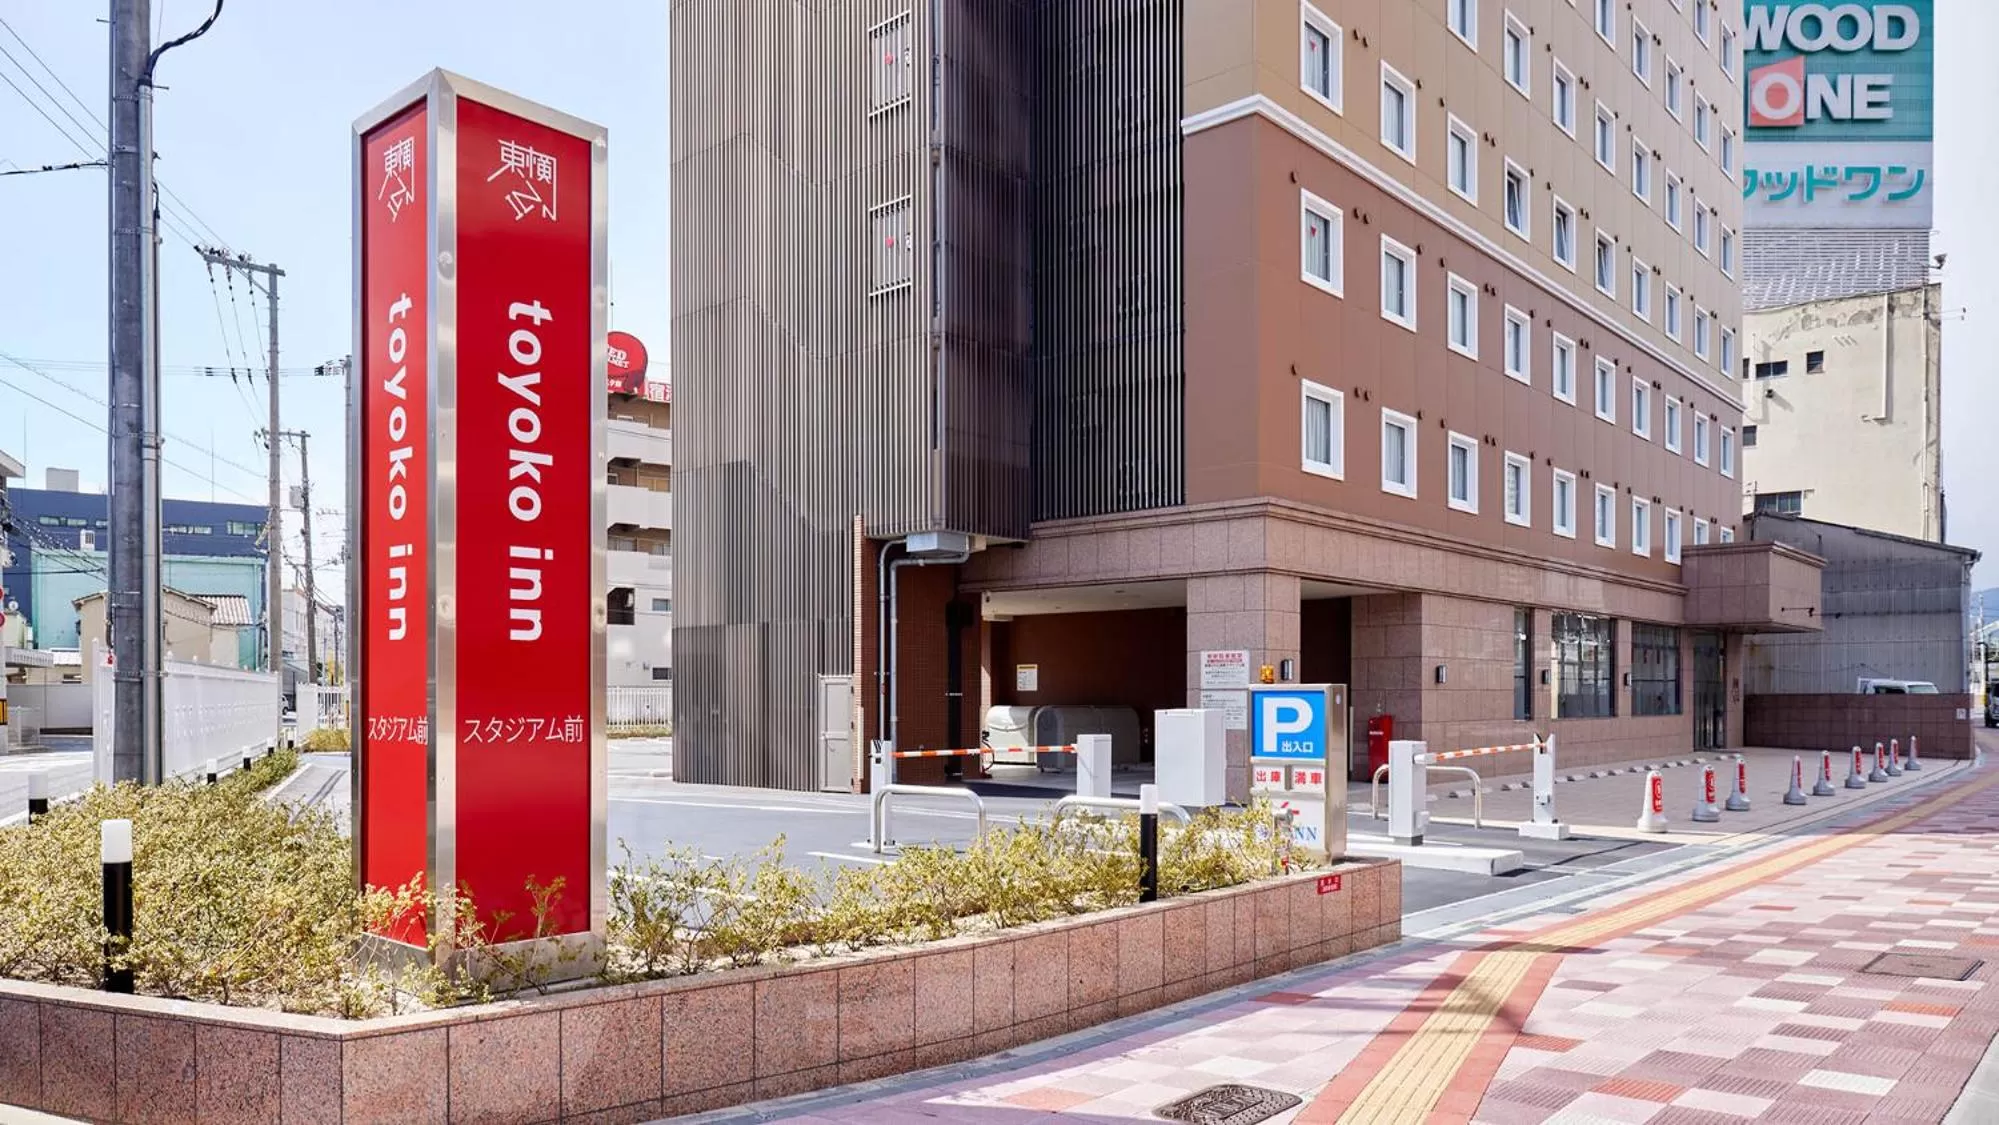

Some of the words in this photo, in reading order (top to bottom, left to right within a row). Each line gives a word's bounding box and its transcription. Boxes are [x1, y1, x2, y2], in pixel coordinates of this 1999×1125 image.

[1743, 4, 1920, 52] WOOD
[1751, 72, 1893, 120] ONE
[607, 346, 627, 361] ED
[384, 293, 413, 521] toyoko
[498, 299, 553, 522] toyoko
[388, 544, 413, 641] inn
[509, 545, 554, 641] inn
[368, 716, 428, 745] スタジアム前
[463, 716, 584, 743] スタジアム前
[1263, 697, 1313, 752] P
[1281, 740, 1313, 753] 出入口
[1291, 826, 1317, 843] NN
